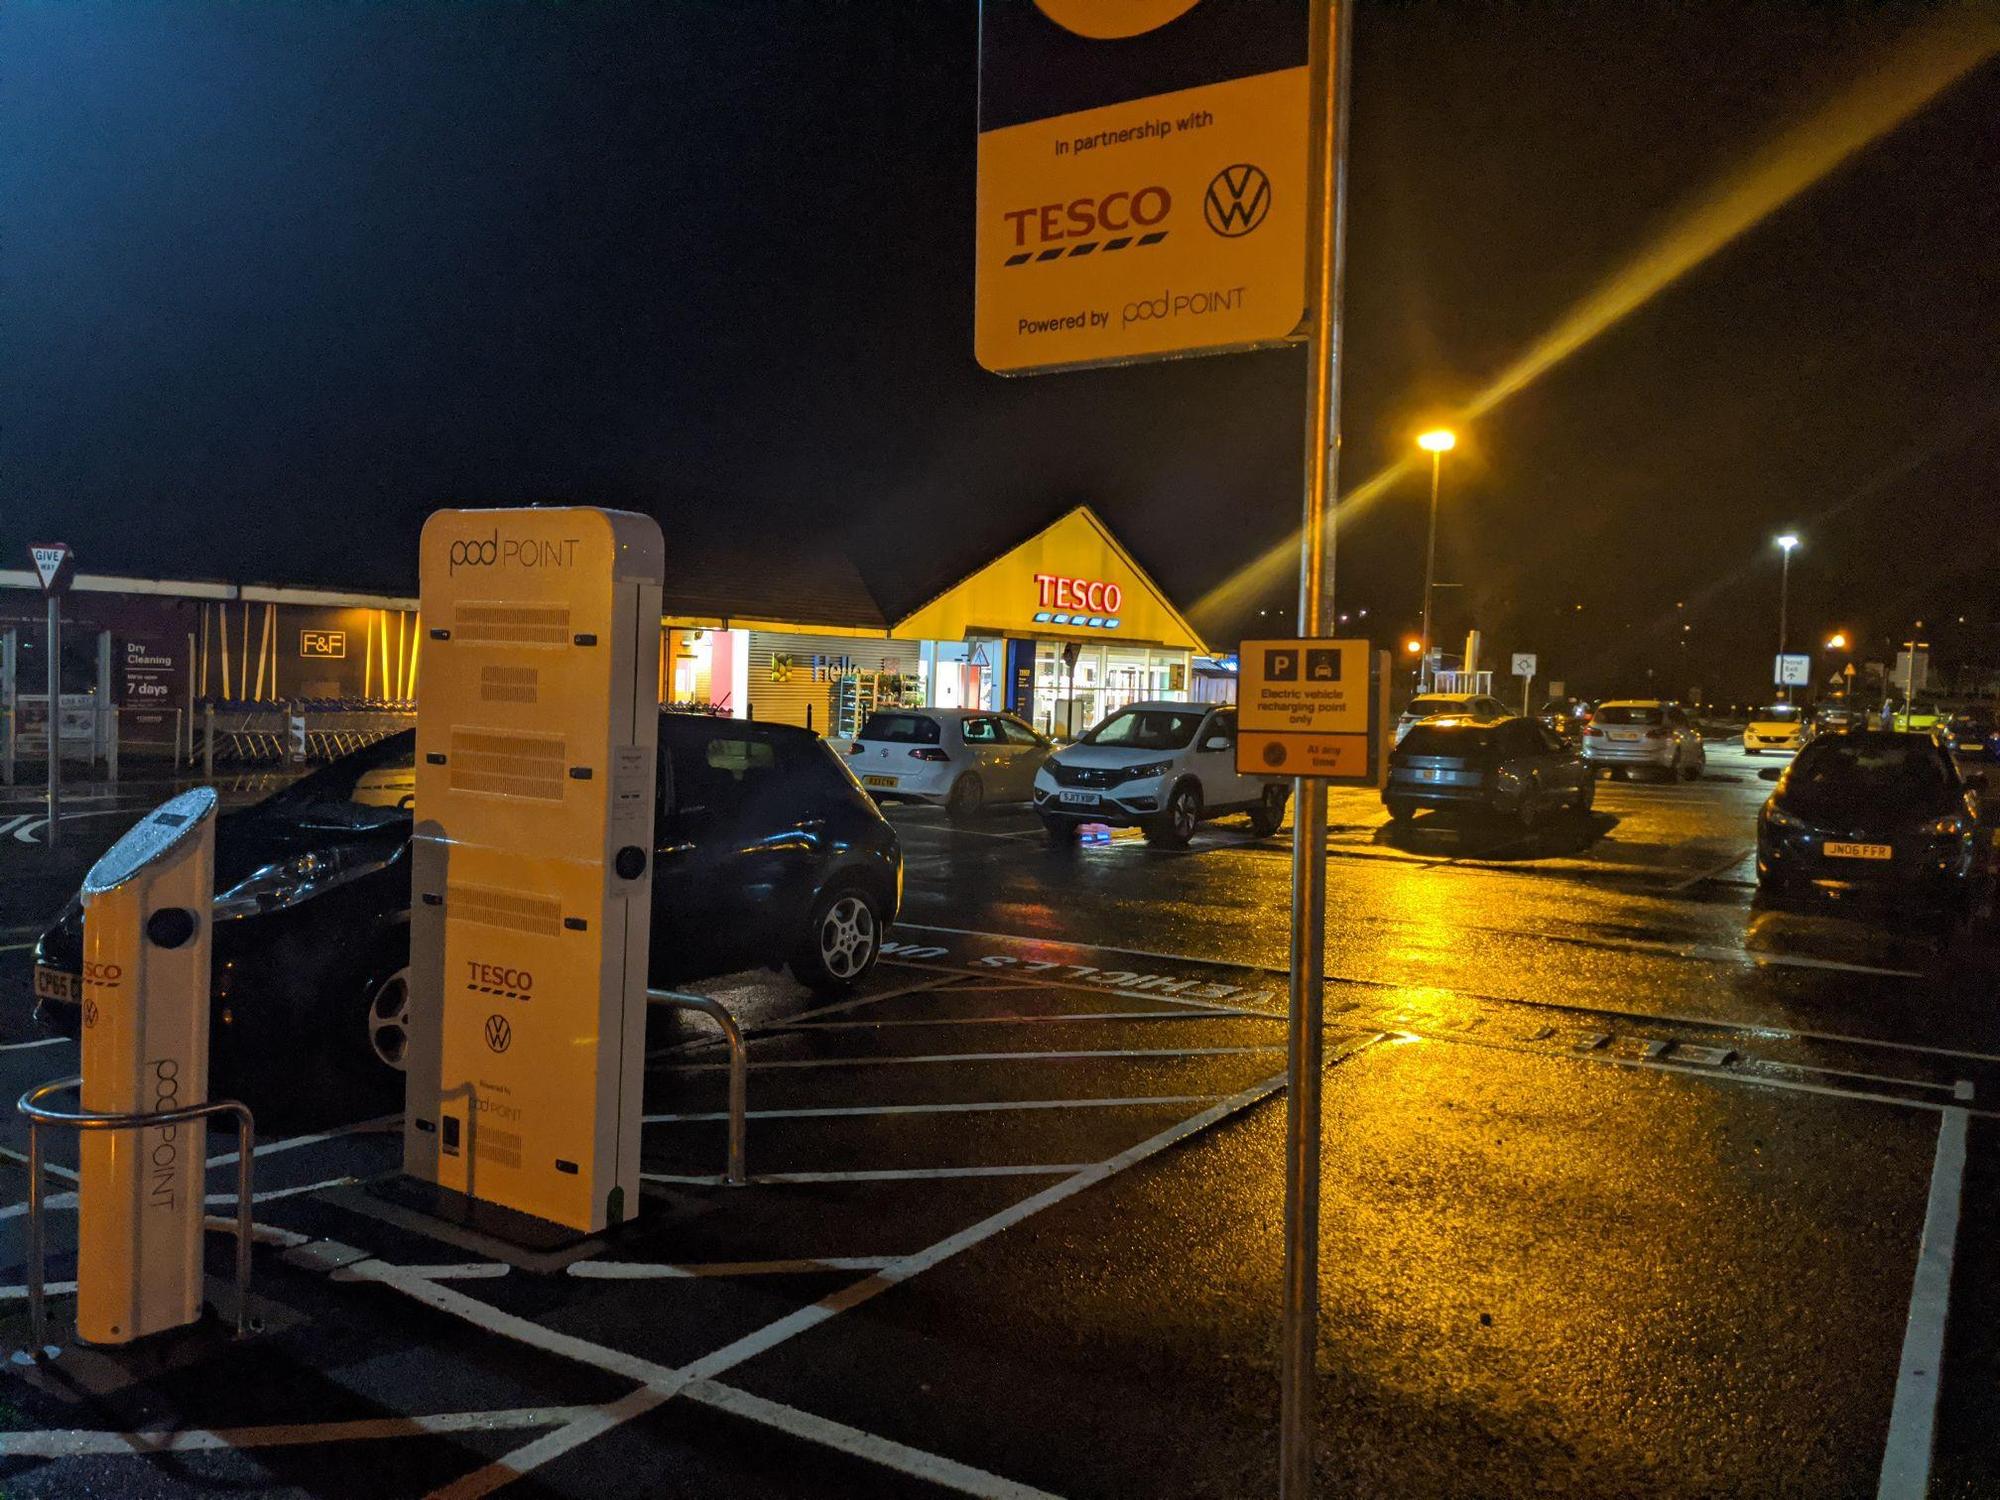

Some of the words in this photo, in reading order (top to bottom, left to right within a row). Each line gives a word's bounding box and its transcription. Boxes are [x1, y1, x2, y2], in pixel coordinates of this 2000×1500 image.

[1055, 139, 1069, 155] In
[1074, 121, 1172, 155] partnership
[1176, 111, 1213, 131] with
[1004, 186, 1172, 246] TESCO
[1018, 312, 1086, 335] Powered
[1090, 310, 1109, 329] by
[1122, 289, 1170, 330] pod
[1173, 287, 1246, 316] POINT
[36, 551, 59, 561] GIVE
[449, 527, 498, 578] pod
[503, 539, 580, 568] POINT
[1034, 574, 1122, 614] TESCO
[127, 643, 146, 654] Dry
[303, 634, 342, 654] F&F
[127, 655, 172, 666] Cleaning
[1274, 656, 1289, 675] P
[127, 683, 136, 694] 7
[138, 683, 168, 696] days
[1261, 688, 1301, 699] Electric
[1304, 689, 1344, 699] vehicle
[1257, 702, 1315, 714] recharging
[1318, 703, 1347, 713] point
[1289, 714, 1312, 726] only
[1307, 745, 1318, 754] At
[1321, 746, 1341, 756] any
[1312, 757, 1337, 767] time
[1830, 845, 1859, 856] JN06
[1862, 845, 1887, 857] FFR
[85, 961, 122, 979] SCO
[467, 961, 533, 991] TESCO
